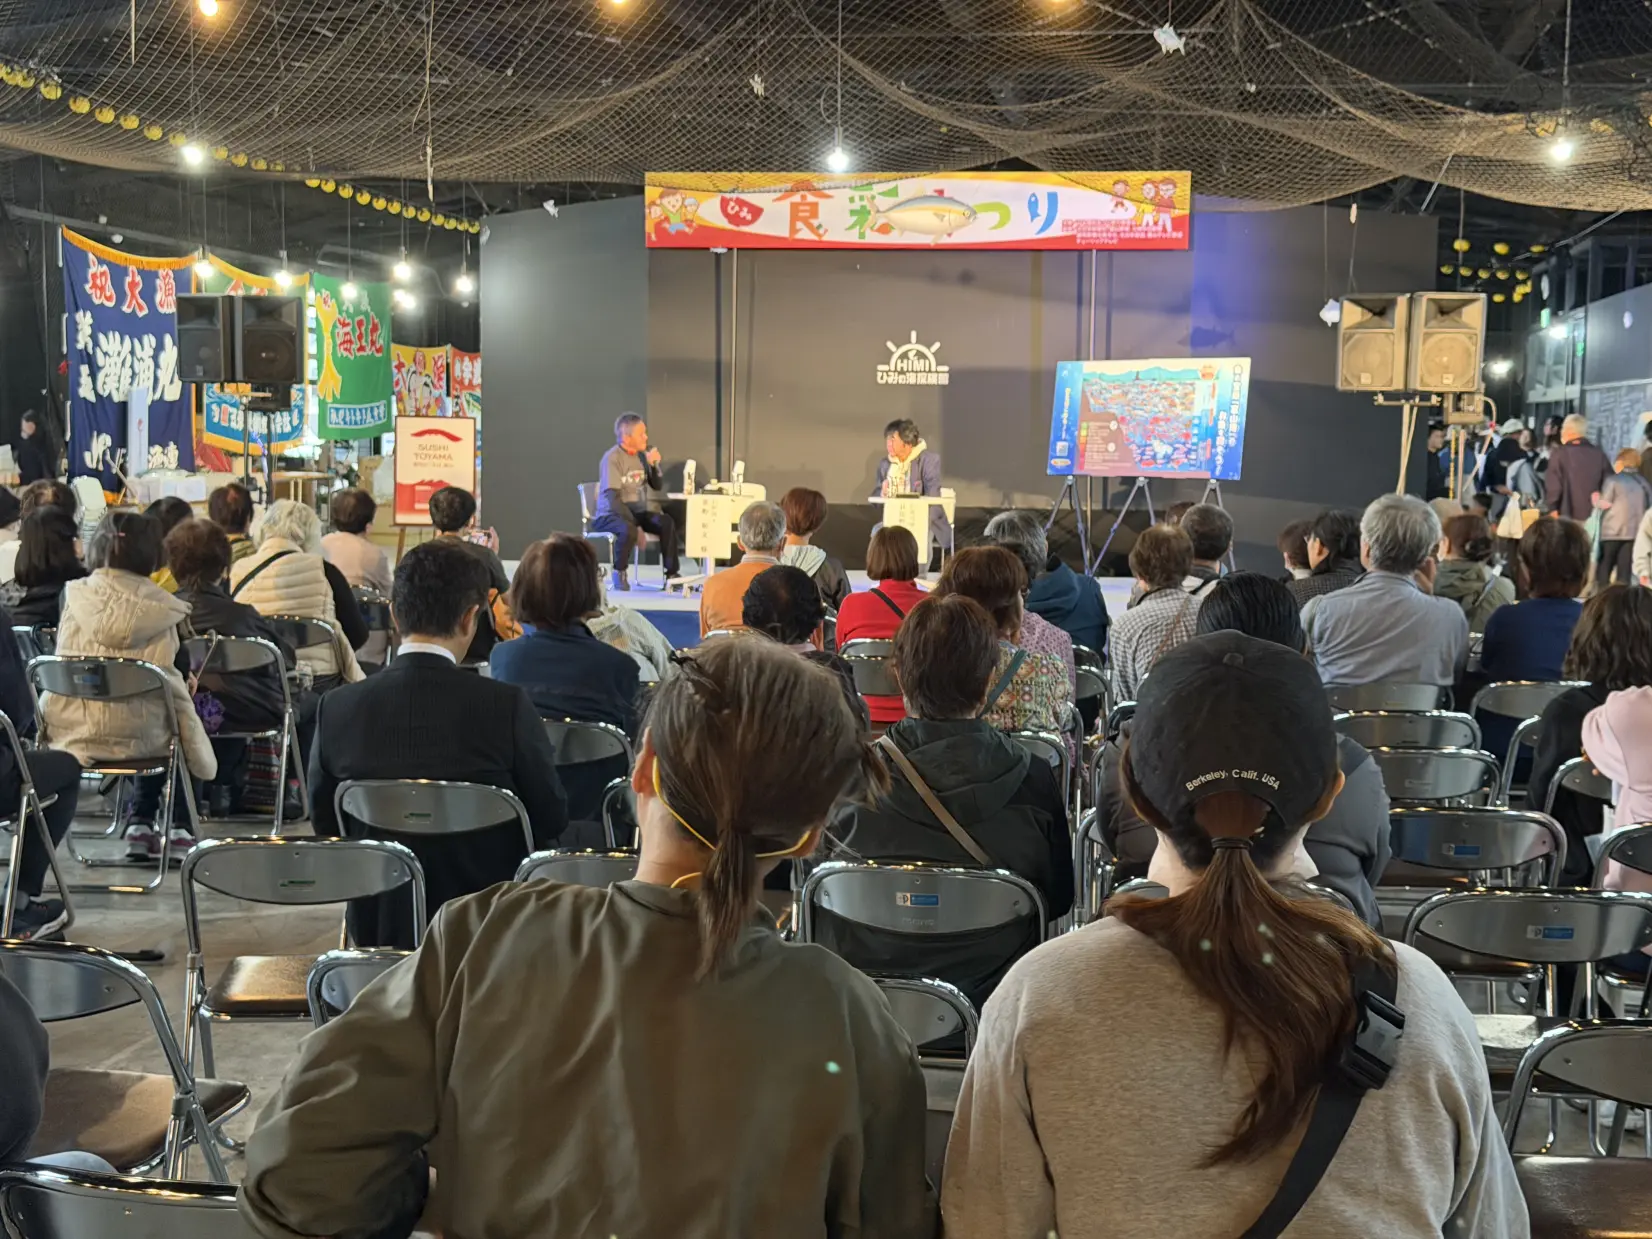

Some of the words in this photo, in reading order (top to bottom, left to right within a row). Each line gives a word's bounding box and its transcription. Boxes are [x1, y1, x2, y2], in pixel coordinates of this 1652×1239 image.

[727, 200, 752, 221] ひみ
[336, 312, 384, 360] 海王丸
[896, 359, 930, 372] HIMI
[418, 444, 449, 452] SUSHI
[413, 453, 454, 461] TOYAMA
[1231, 768, 1259, 781] Calif.
[1261, 773, 1281, 790] USA
